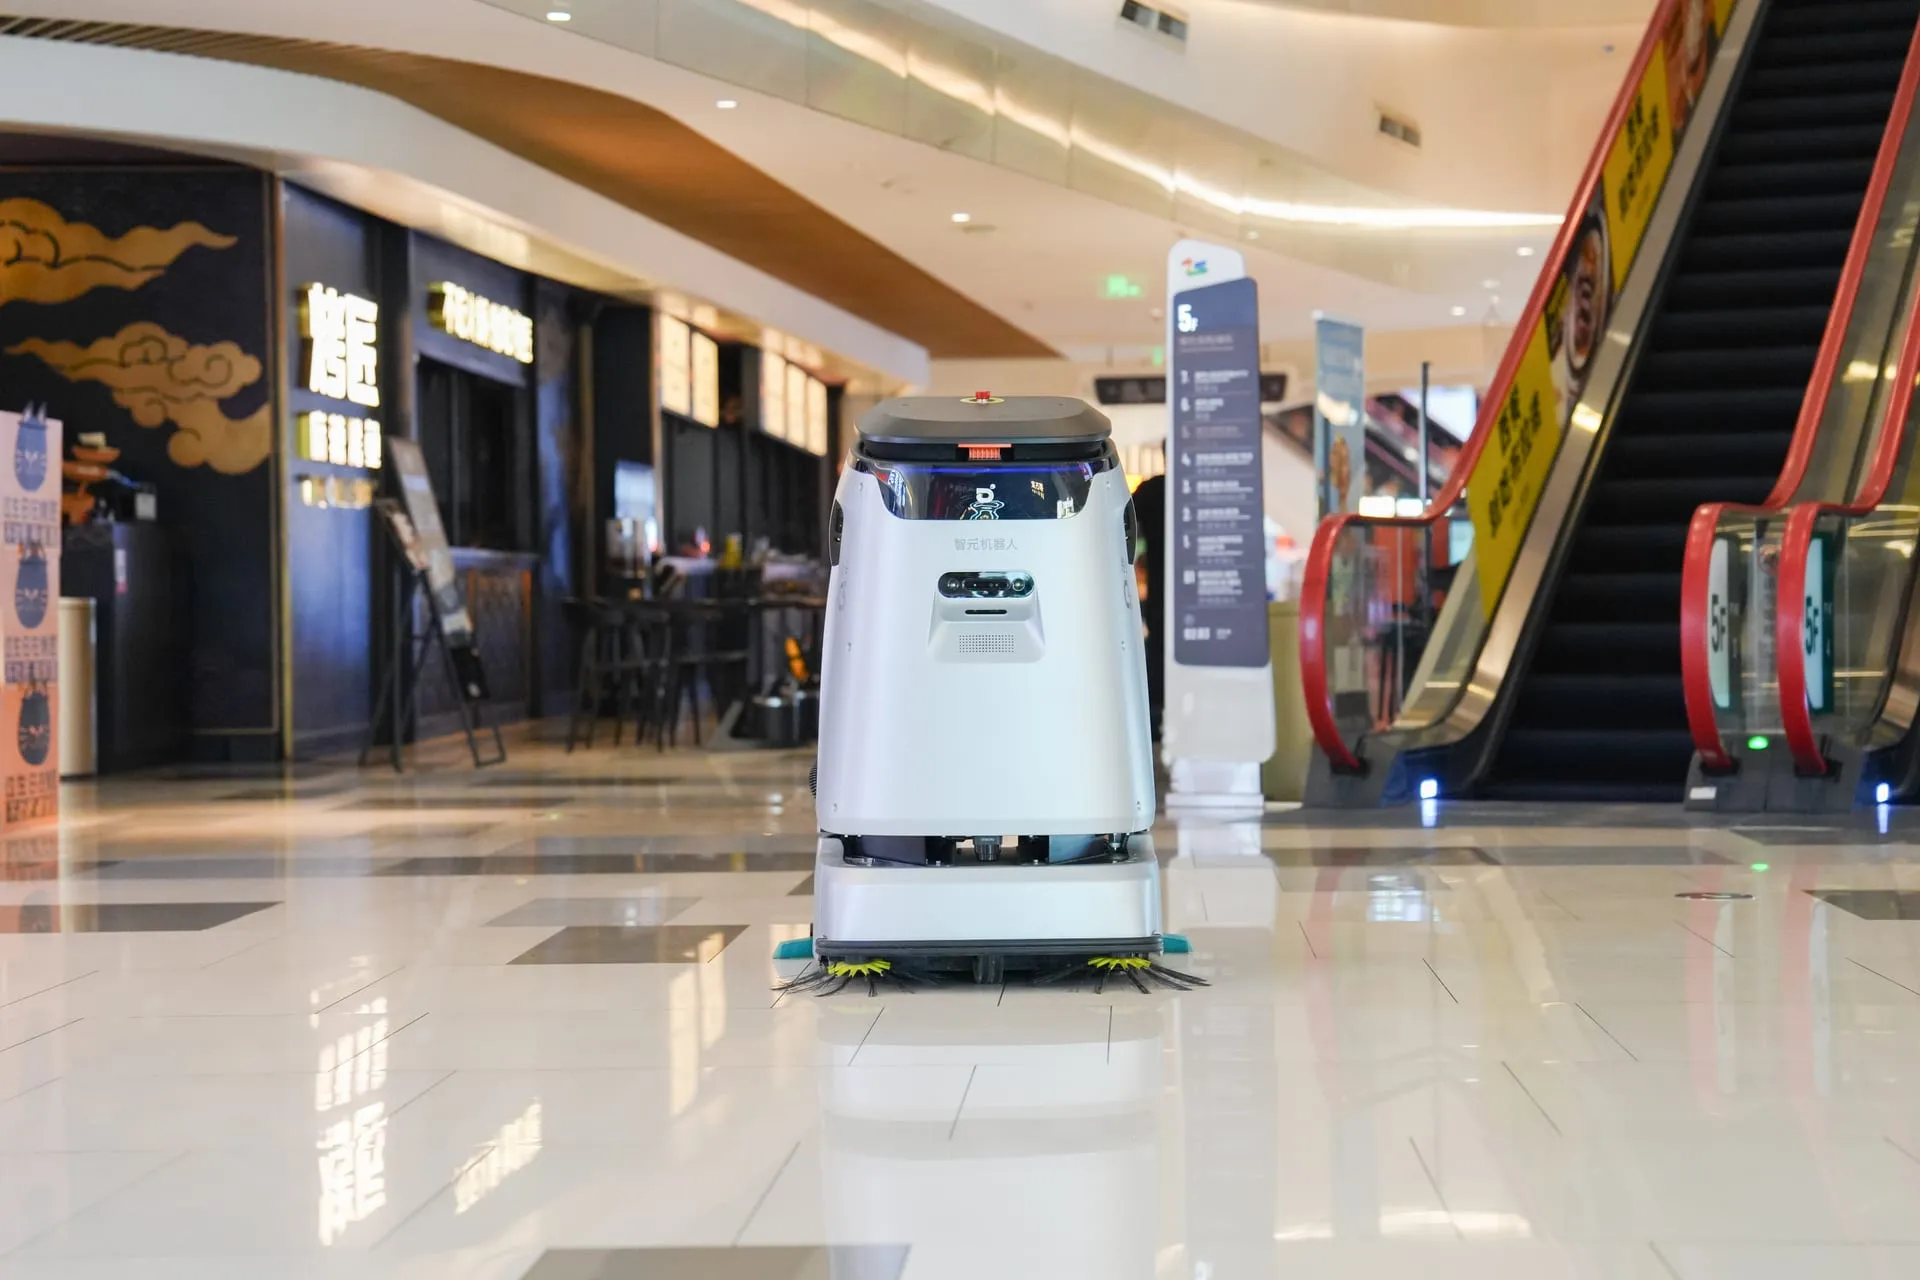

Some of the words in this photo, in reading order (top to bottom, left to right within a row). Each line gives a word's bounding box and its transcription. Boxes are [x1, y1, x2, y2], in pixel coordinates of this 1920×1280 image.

[954, 537, 1018, 551] 智元机器人
